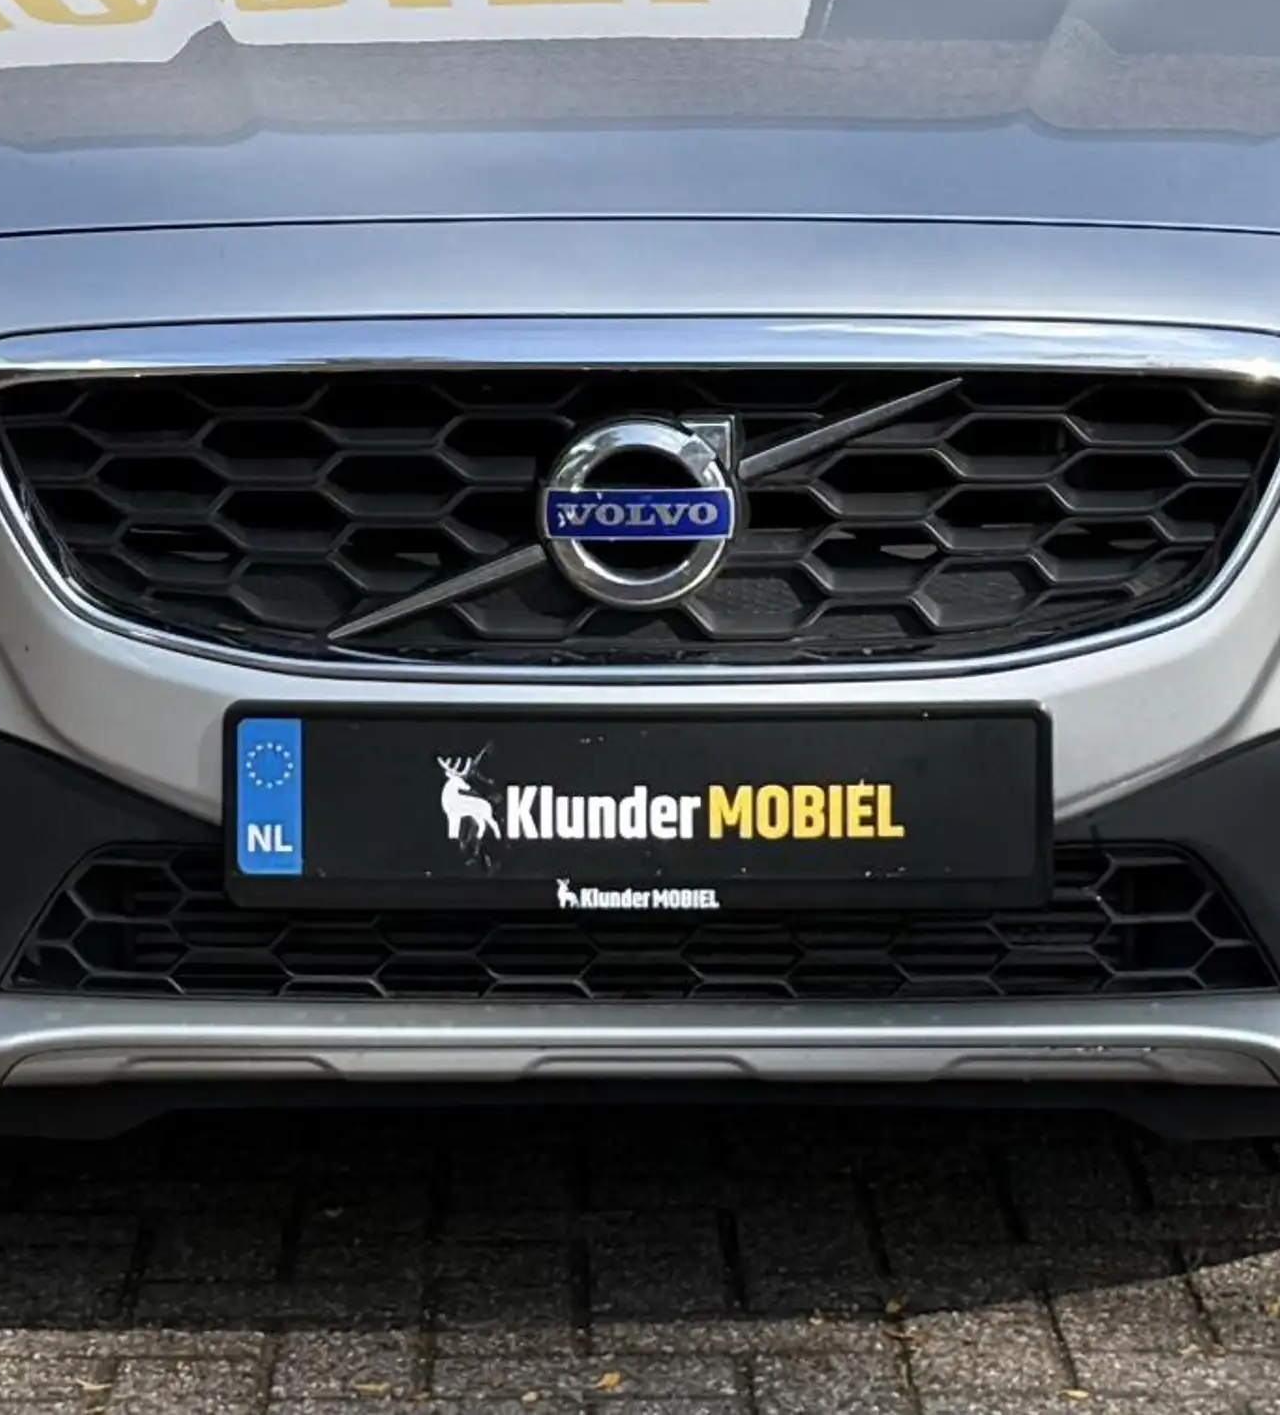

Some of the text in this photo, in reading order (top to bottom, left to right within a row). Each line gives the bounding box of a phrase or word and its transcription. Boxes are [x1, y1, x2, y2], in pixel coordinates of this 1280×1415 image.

[556, 502, 719, 526] VOLVO
[506, 783, 906, 840] Klunder MOBIEL
[247, 823, 294, 853] NL
[580, 888, 720, 909] Klunder MOBIEL
